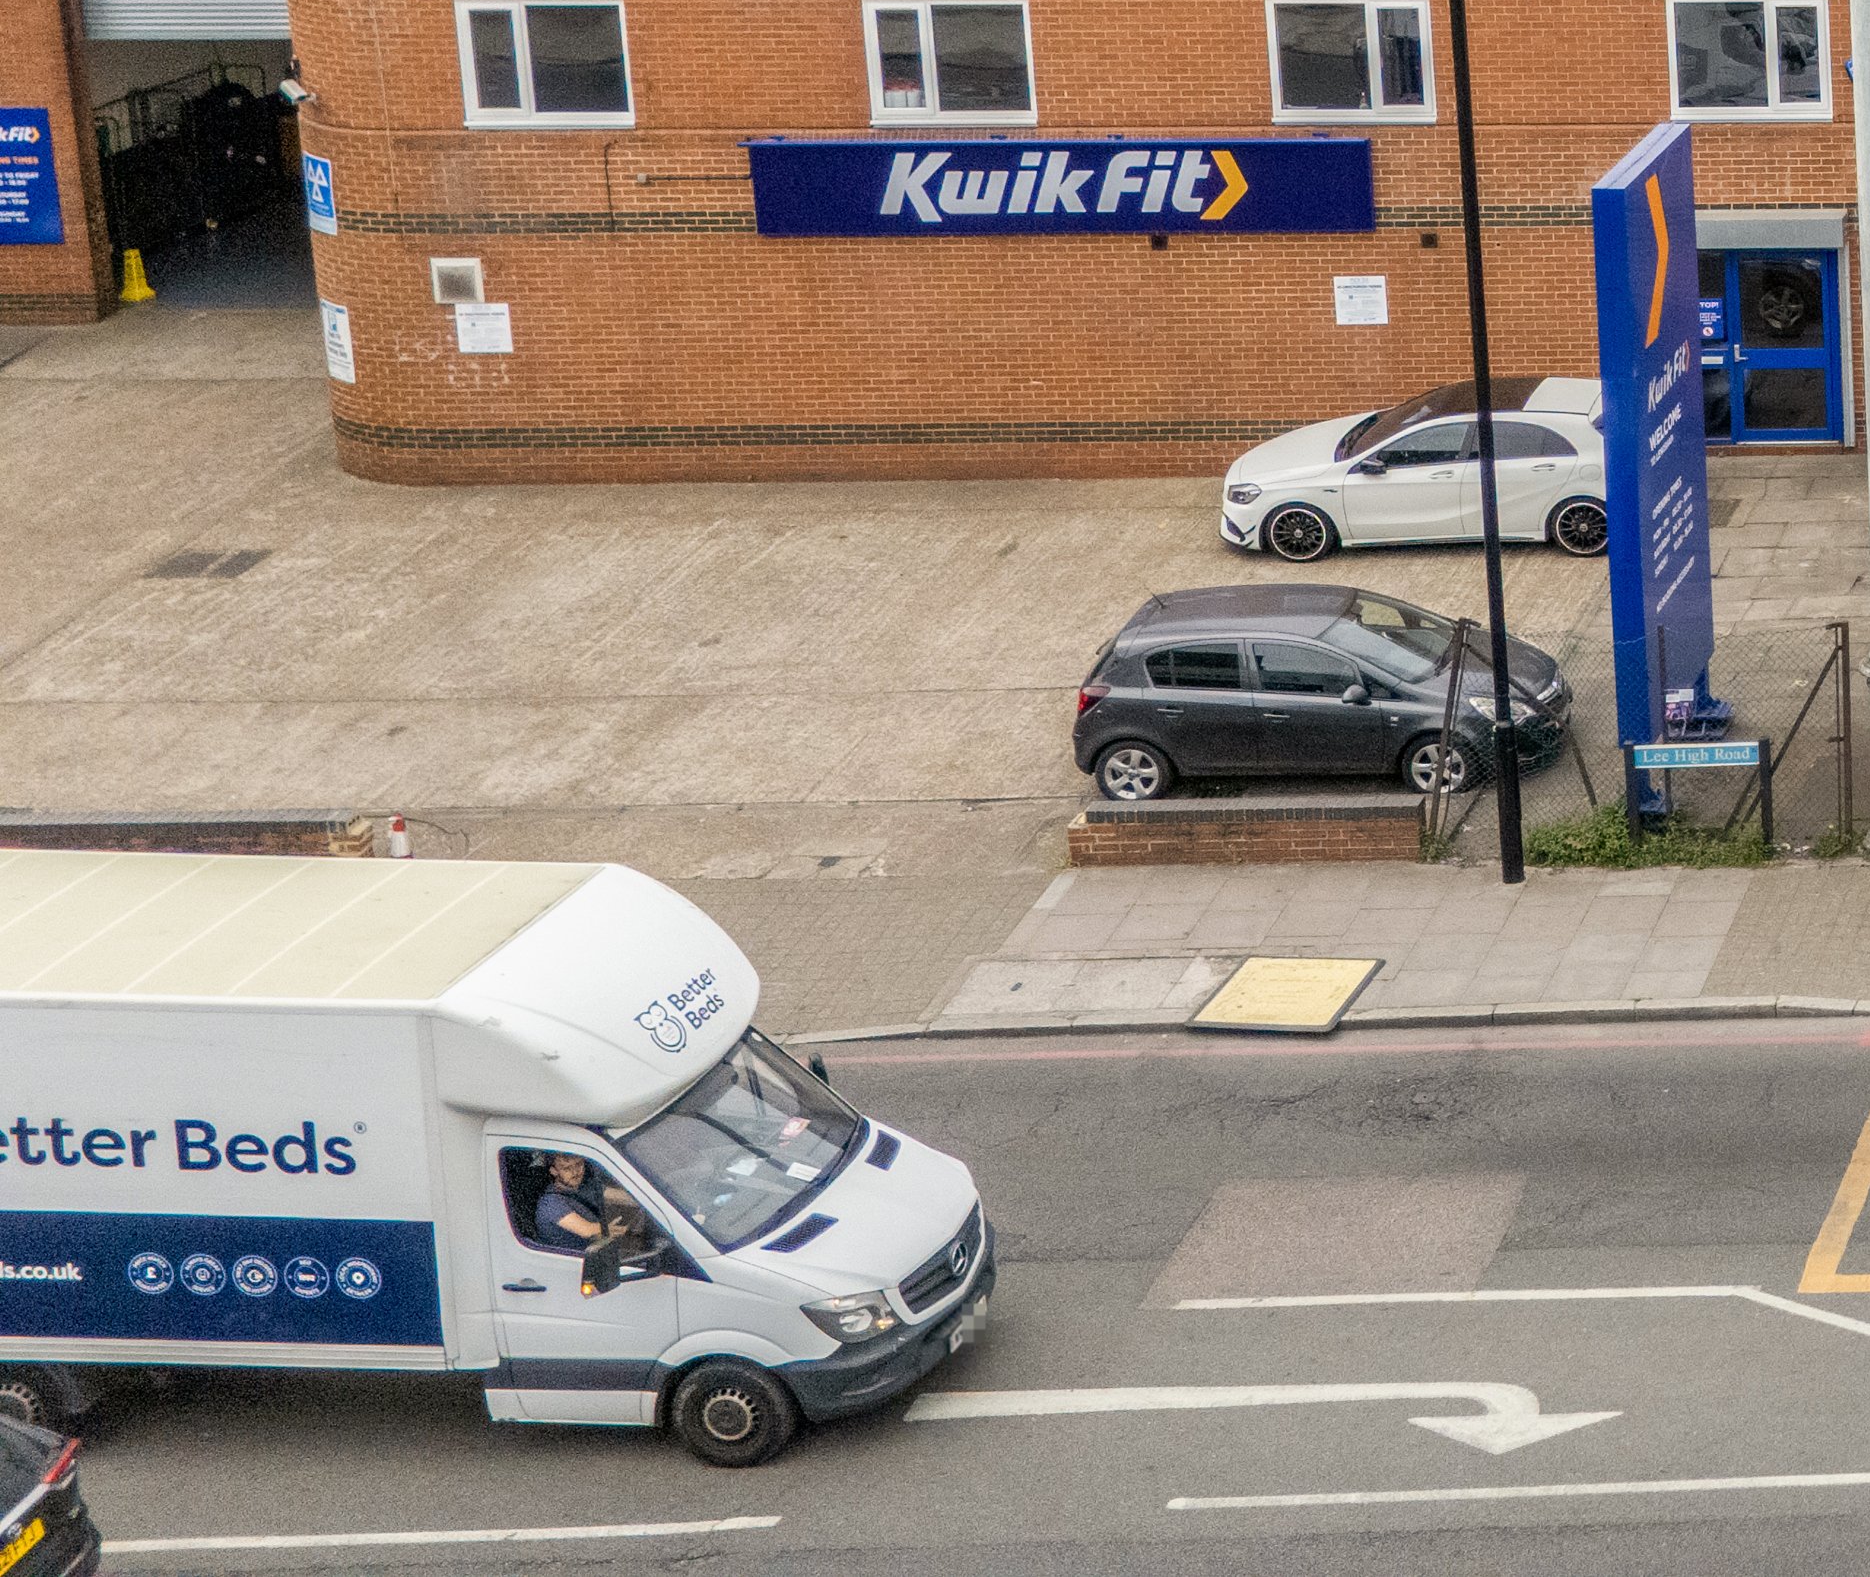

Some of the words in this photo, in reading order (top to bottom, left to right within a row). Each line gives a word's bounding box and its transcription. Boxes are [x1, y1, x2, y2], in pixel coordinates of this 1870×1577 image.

[1648, 359, 1673, 413] Kwik
[1649, 401, 1682, 451] WELCOME
[1643, 750, 1669, 763] Lee
[1675, 747, 1709, 765] High
[1714, 747, 1750, 761] Road
[667, 968, 716, 1012] Better
[685, 994, 725, 1030] Beds
[0, 1116, 157, 1168] tter
[174, 1119, 357, 1176] Beds
[0, 1261, 83, 1282] s.co.uk
